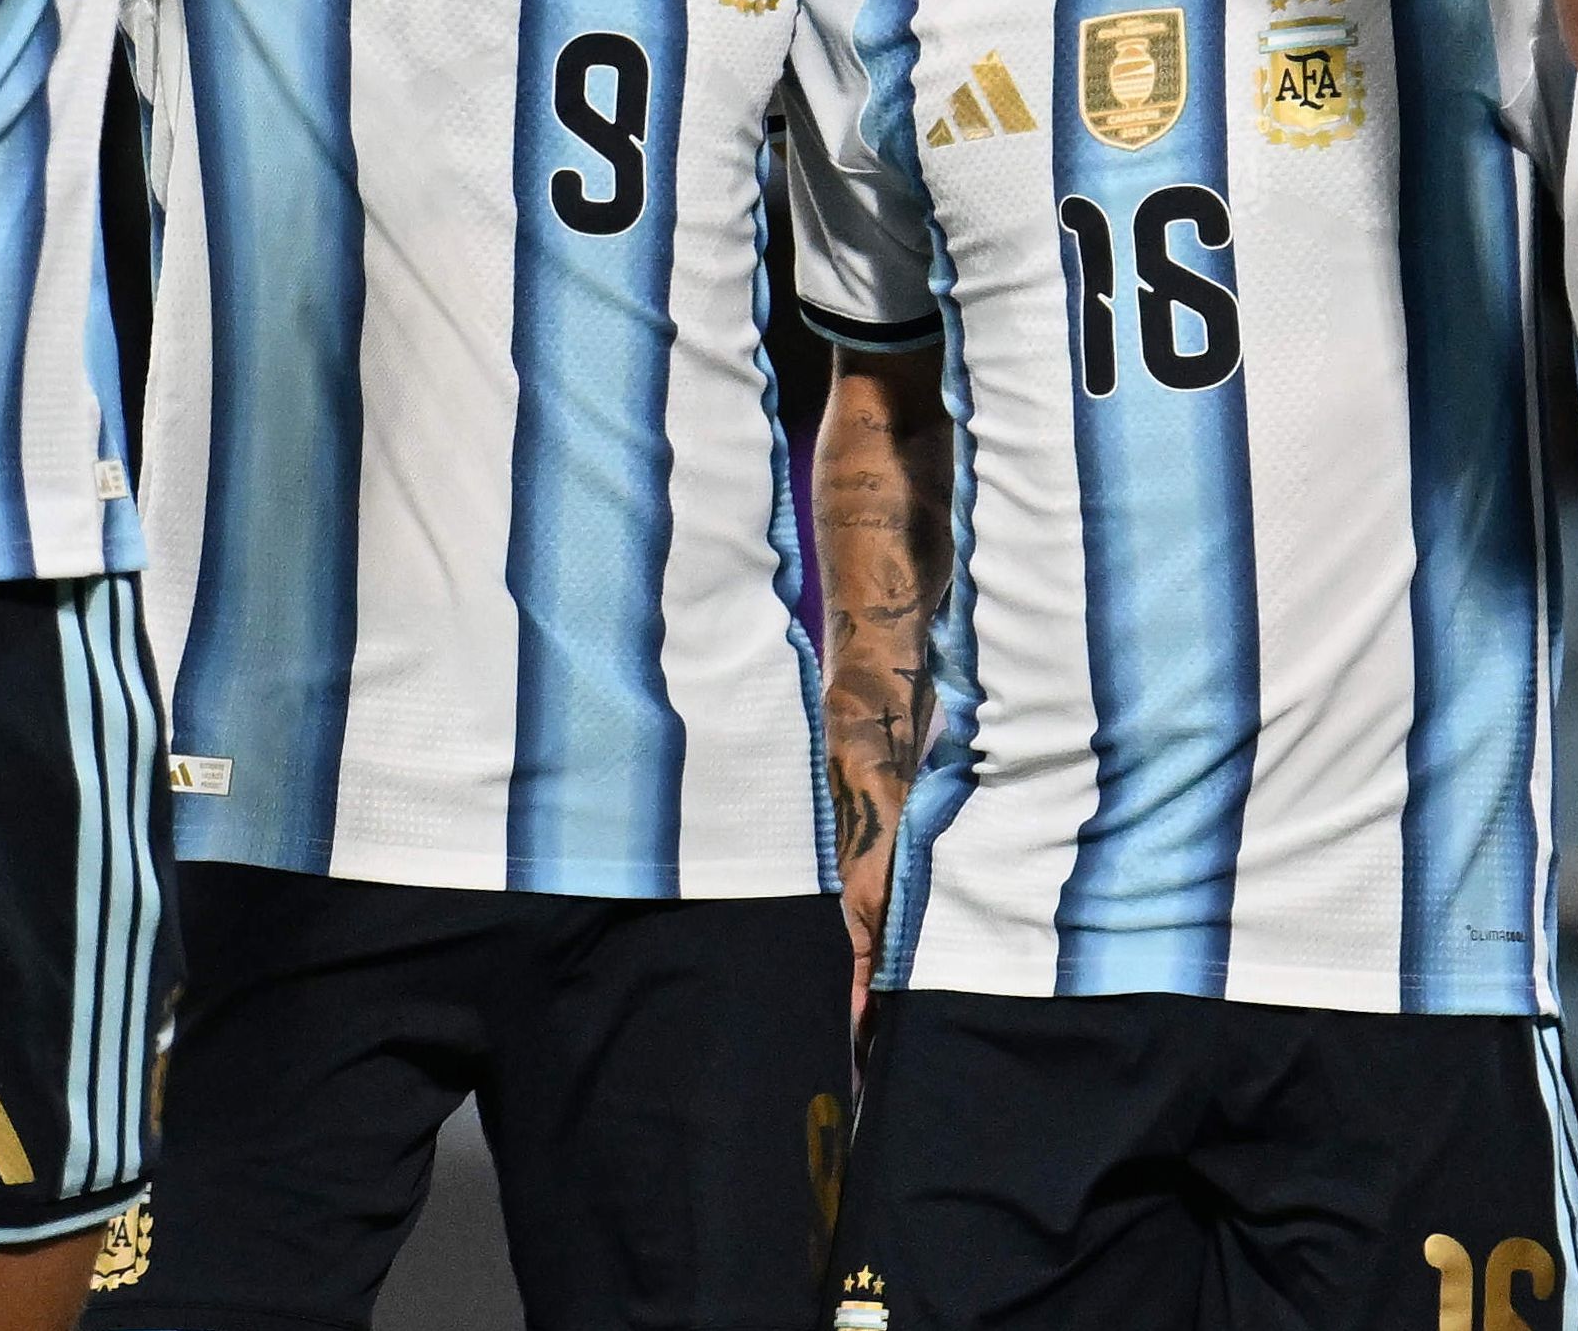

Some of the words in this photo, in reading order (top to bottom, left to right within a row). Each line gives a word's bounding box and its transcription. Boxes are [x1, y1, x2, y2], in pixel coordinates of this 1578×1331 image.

[549, 31, 652, 238] 9
[1275, 50, 1342, 110] AFA
[1058, 183, 1243, 399] 16
